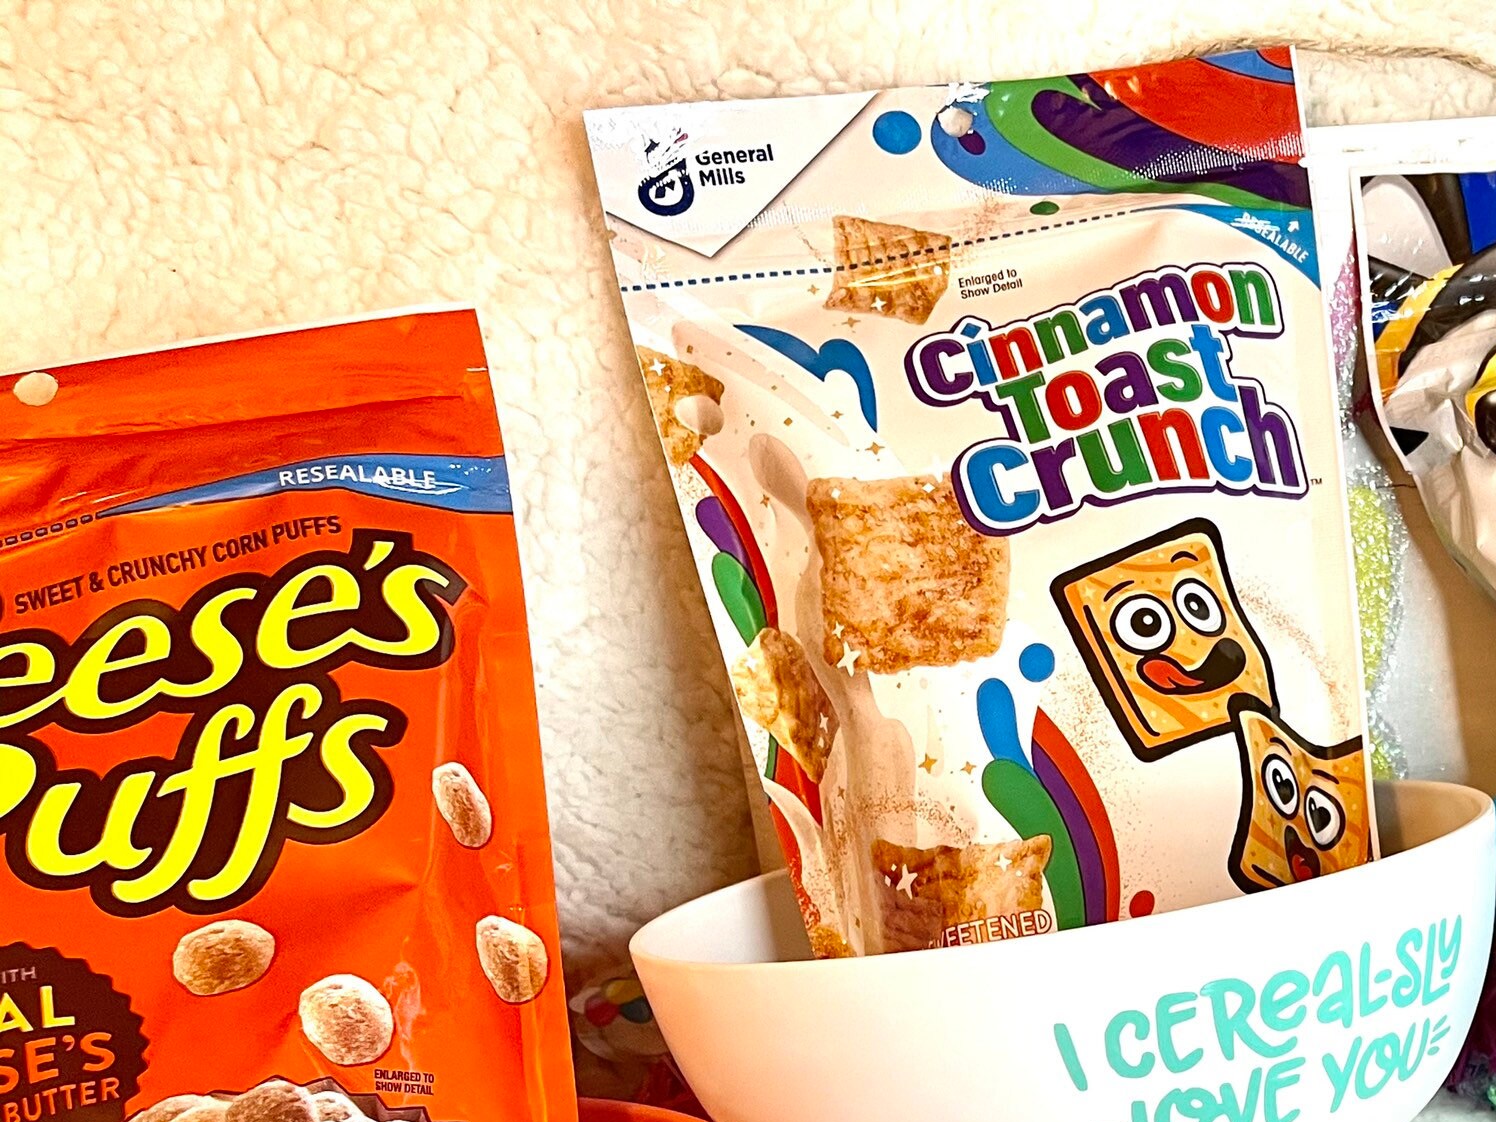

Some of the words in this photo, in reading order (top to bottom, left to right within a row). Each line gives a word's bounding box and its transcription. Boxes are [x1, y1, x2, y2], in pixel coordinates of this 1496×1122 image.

[695, 144, 774, 166] General
[699, 167, 746, 187] Mills
[958, 269, 1004, 288] Enlarged
[1006, 268, 1018, 278] to
[960, 287, 990, 299] Show
[993, 278, 1023, 293] Detail
[918, 265, 1279, 396] Cinnamon
[995, 324, 1237, 445] Toast
[966, 385, 1301, 523] Crunch
[278, 464, 437, 490] RESEALABLE
[14, 574, 85, 615] SWEET
[88, 571, 105, 593] &
[107, 545, 208, 587] CRUNCHY
[212, 529, 268, 563] CORN
[270, 515, 342, 546] PUFFS
[1053, 1022, 1088, 1092] I
[1321, 1017, 1429, 1112] YOU
[374, 1068, 421, 1082] ENLARGED
[423, 1073, 435, 1083] TO
[375, 1081, 402, 1093] SHOW
[404, 1083, 435, 1096] DETAIL
